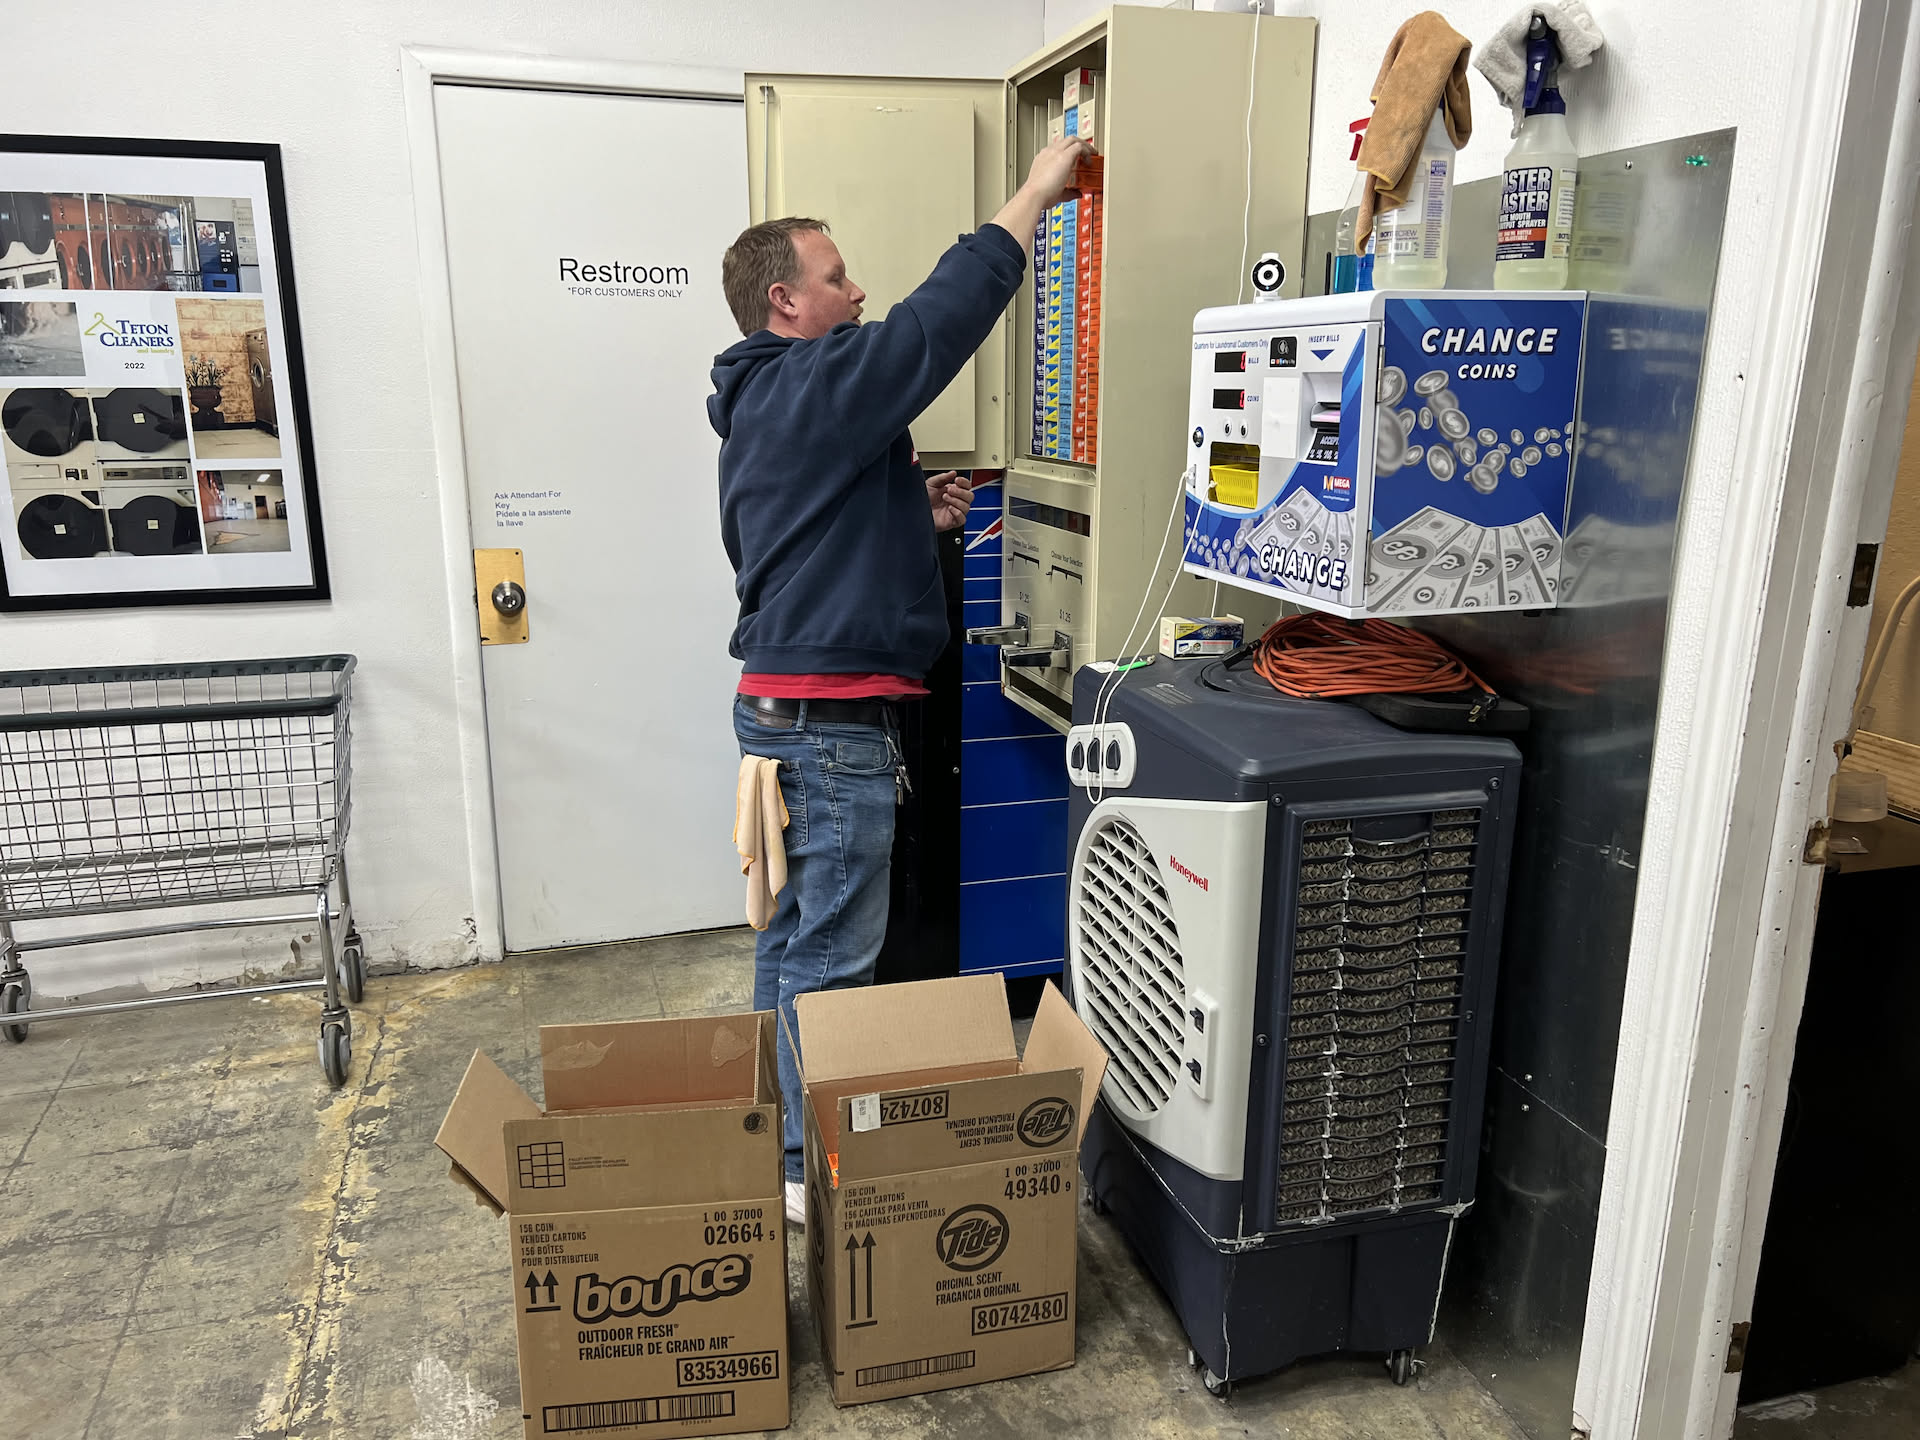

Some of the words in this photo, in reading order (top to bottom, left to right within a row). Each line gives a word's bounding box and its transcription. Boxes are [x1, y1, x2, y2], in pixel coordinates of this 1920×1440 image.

[1517, 219, 1546, 228] SPRAYER
[560, 258, 688, 284] Restroom
[595, 288, 655, 297] CUSTOMERS
[658, 290, 682, 298] ONLY
[116, 320, 168, 334] TETON
[100, 332, 174, 346] CLEANERS
[1238, 339, 1259, 348] Customers
[1259, 338, 1269, 349] Only
[1326, 334, 1340, 342] BILLS
[1422, 328, 1558, 353] CHANGE
[1458, 364, 1517, 379] COINS
[1334, 477, 1350, 489] MEGA
[511, 491, 546, 499] Attendant
[495, 502, 510, 510] Key
[1260, 544, 1346, 590] CHANGE
[1060, 609, 1071, 623] $1.25
[1170, 855, 1208, 892] Honeywell
[881, 1096, 944, 1121] 807424
[945, 1118, 977, 1130] ORIGINAL
[979, 1113, 1015, 1125] FRAGANCIA
[1022, 1103, 1071, 1136] Tide
[955, 1126, 985, 1139] ORIGINAL
[987, 1123, 1014, 1134] PARFUM
[960, 1138, 981, 1148] SCENT
[983, 1133, 1013, 1144] ORIGINAL
[1005, 1168, 1010, 1178] 1
[1016, 1165, 1027, 1176] 00
[1033, 1160, 1060, 1174] 37000
[860, 1186, 876, 1196] COIN
[1004, 1174, 1060, 1200] 49340
[1065, 1181, 1071, 1191] 9
[844, 1198, 871, 1208] VENDED
[874, 1192, 905, 1204] CARTONS
[704, 1212, 708, 1222] 1
[714, 1211, 726, 1222] 00
[733, 1208, 762, 1220] 37000
[845, 1211, 857, 1219] 156
[860, 1206, 885, 1217] CAJITAS
[888, 1204, 905, 1213] PARA
[908, 1200, 928, 1210] VENTA
[845, 1222, 853, 1230] EN
[893, 1208, 946, 1223] EXPENDEDORAS
[536, 1223, 554, 1232] COIN
[704, 1222, 763, 1245] 02664
[770, 1230, 775, 1240] 5
[520, 1234, 550, 1244] VENDED
[553, 1232, 586, 1242] CARTONS
[944, 1220, 1002, 1264] Tide
[538, 1244, 564, 1254] BOÎTES
[522, 1258, 542, 1267] POUR
[545, 1253, 599, 1265] DISTRIBUTEUR
[573, 1253, 751, 1324] bounce
[936, 1276, 974, 1292] ORIGINAL
[976, 1272, 1002, 1285] SCENT
[936, 1289, 980, 1306] FRAGANCIA
[984, 1282, 1021, 1298] ORIGINAL
[977, 1298, 1063, 1330] 80742480
[578, 1328, 633, 1344] OUTDOOR
[579, 1342, 644, 1360] FRAÎCHEUR
[648, 1342, 662, 1354] DE
[666, 1339, 705, 1353] GRAND
[684, 1356, 772, 1382] 83534966
